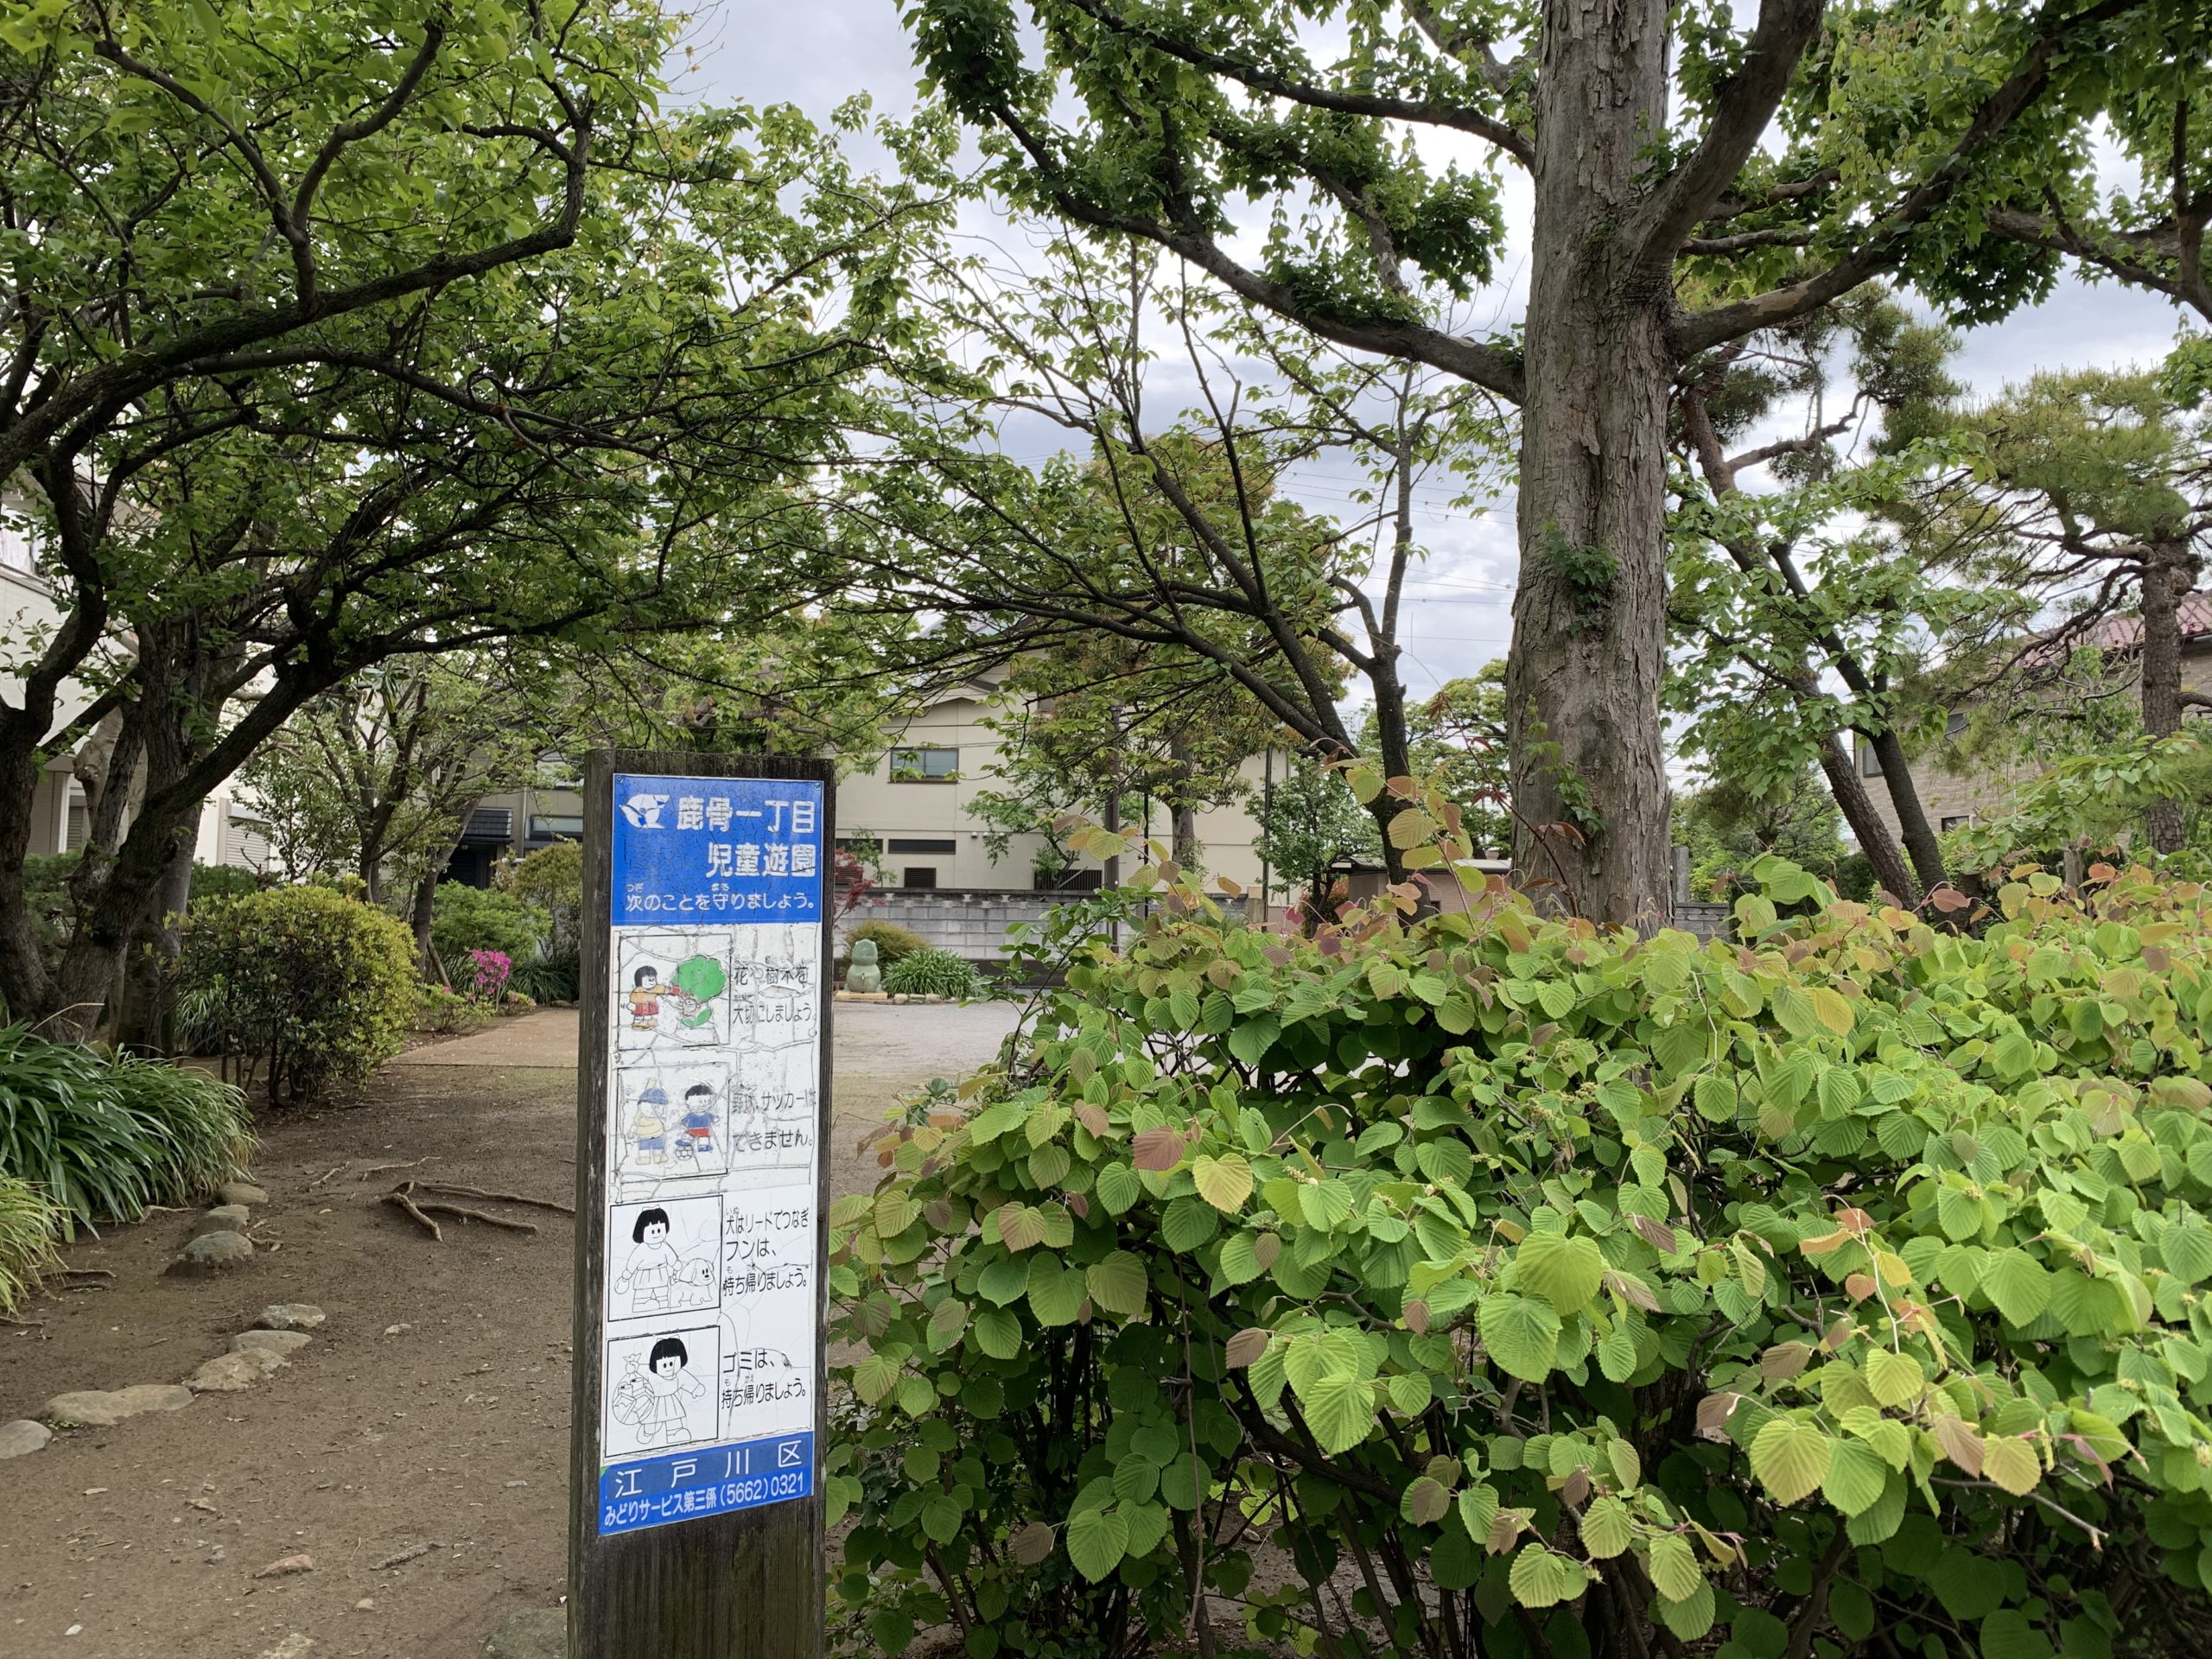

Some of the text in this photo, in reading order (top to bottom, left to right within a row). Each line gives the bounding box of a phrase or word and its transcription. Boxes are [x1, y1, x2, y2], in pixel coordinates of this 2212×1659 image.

[677, 795, 816, 834] 鹿骨一丁目
[705, 842, 817, 879] 児童遊園
[625, 892, 815, 912] 次のことを守りましょう。
[733, 1128, 813, 1153] できません。
[725, 1207, 809, 1236] 犬はリードでつなぎ
[726, 1237, 776, 1262] フンは、
[722, 1268, 807, 1297] 持ち帰りましょう。
[723, 1348, 774, 1373] ゴミは、
[721, 1377, 806, 1410] 持ち帰りましょう。
[614, 1440, 802, 1498] 江戸川区
